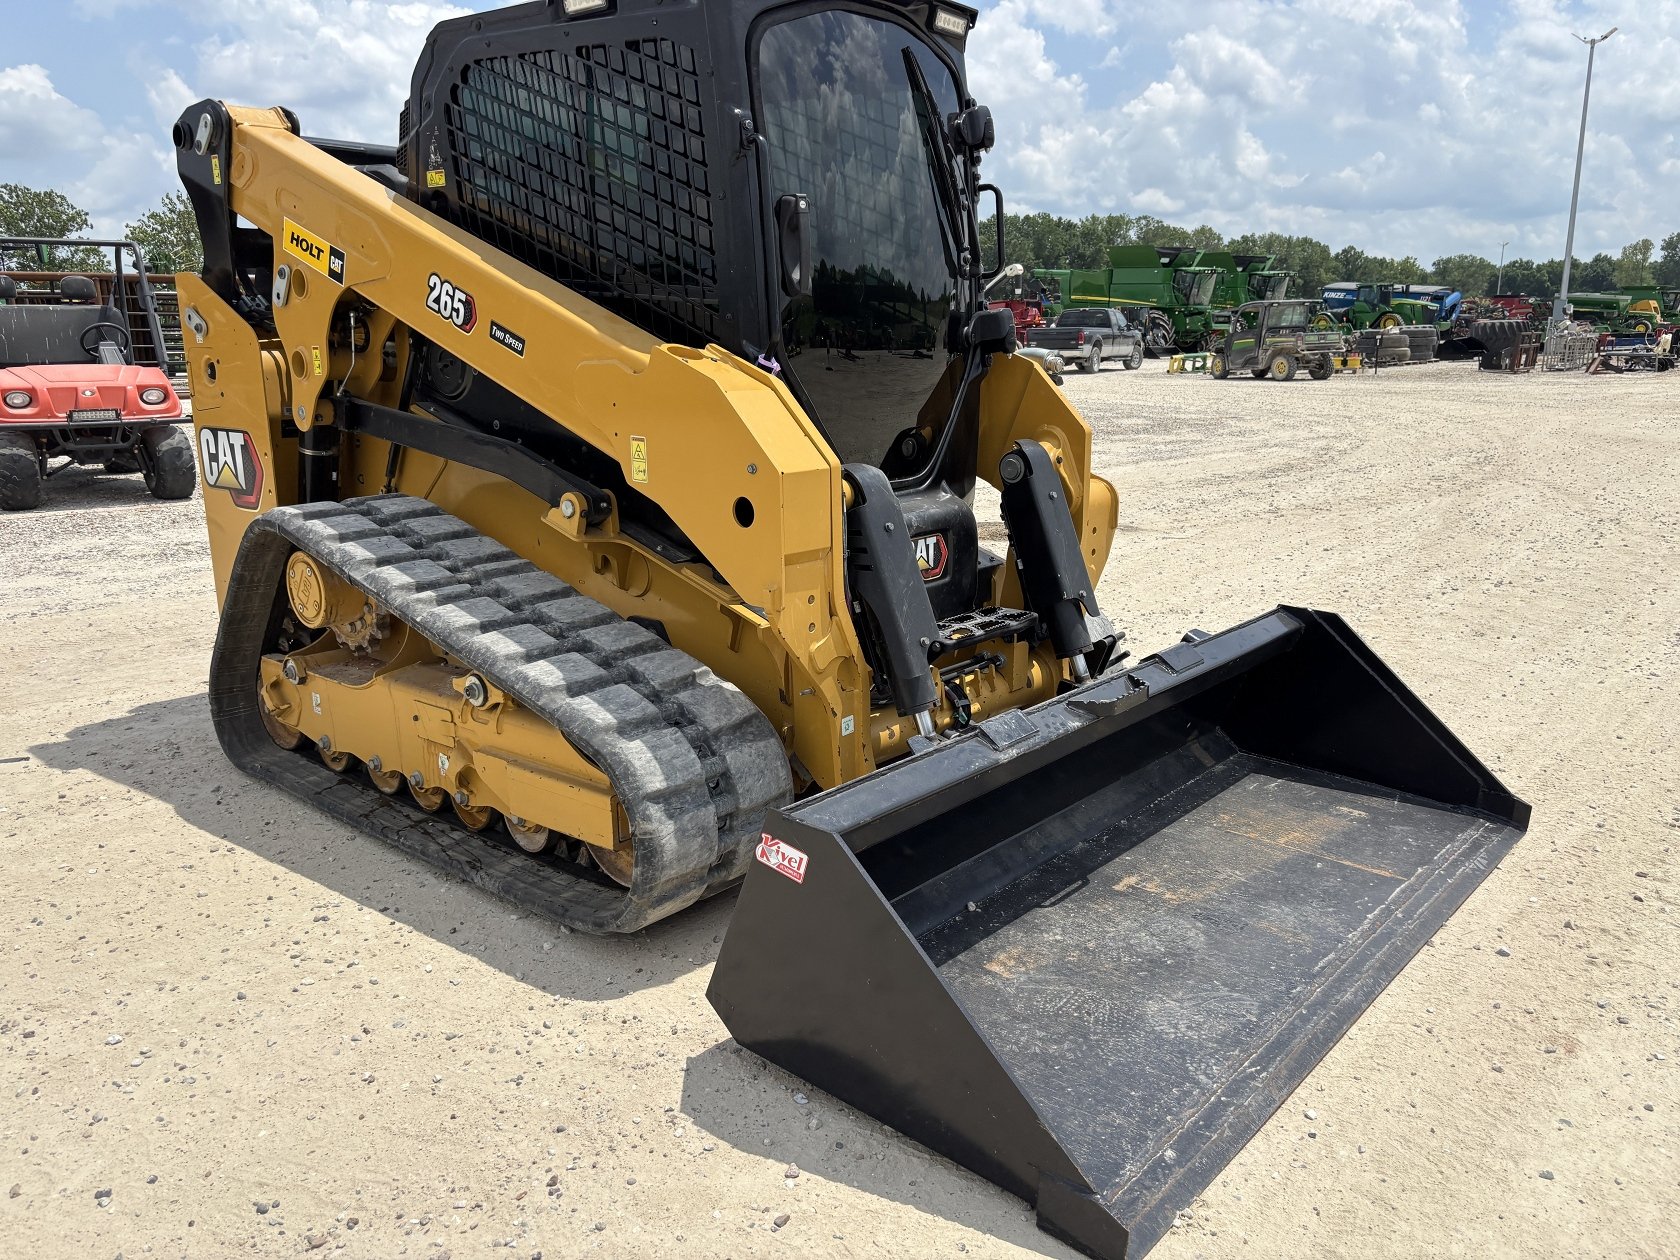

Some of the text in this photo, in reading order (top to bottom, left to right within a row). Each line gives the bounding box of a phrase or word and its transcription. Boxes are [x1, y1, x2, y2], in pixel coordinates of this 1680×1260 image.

[290, 231, 343, 274] HOLT CAT
[427, 274, 466, 326] 265
[1322, 291, 1347, 299] KINZE
[504, 333, 523, 351] SPEED
[200, 428, 247, 490] CAT
[911, 536, 937, 568] AT
[760, 835, 804, 872] Kivel
